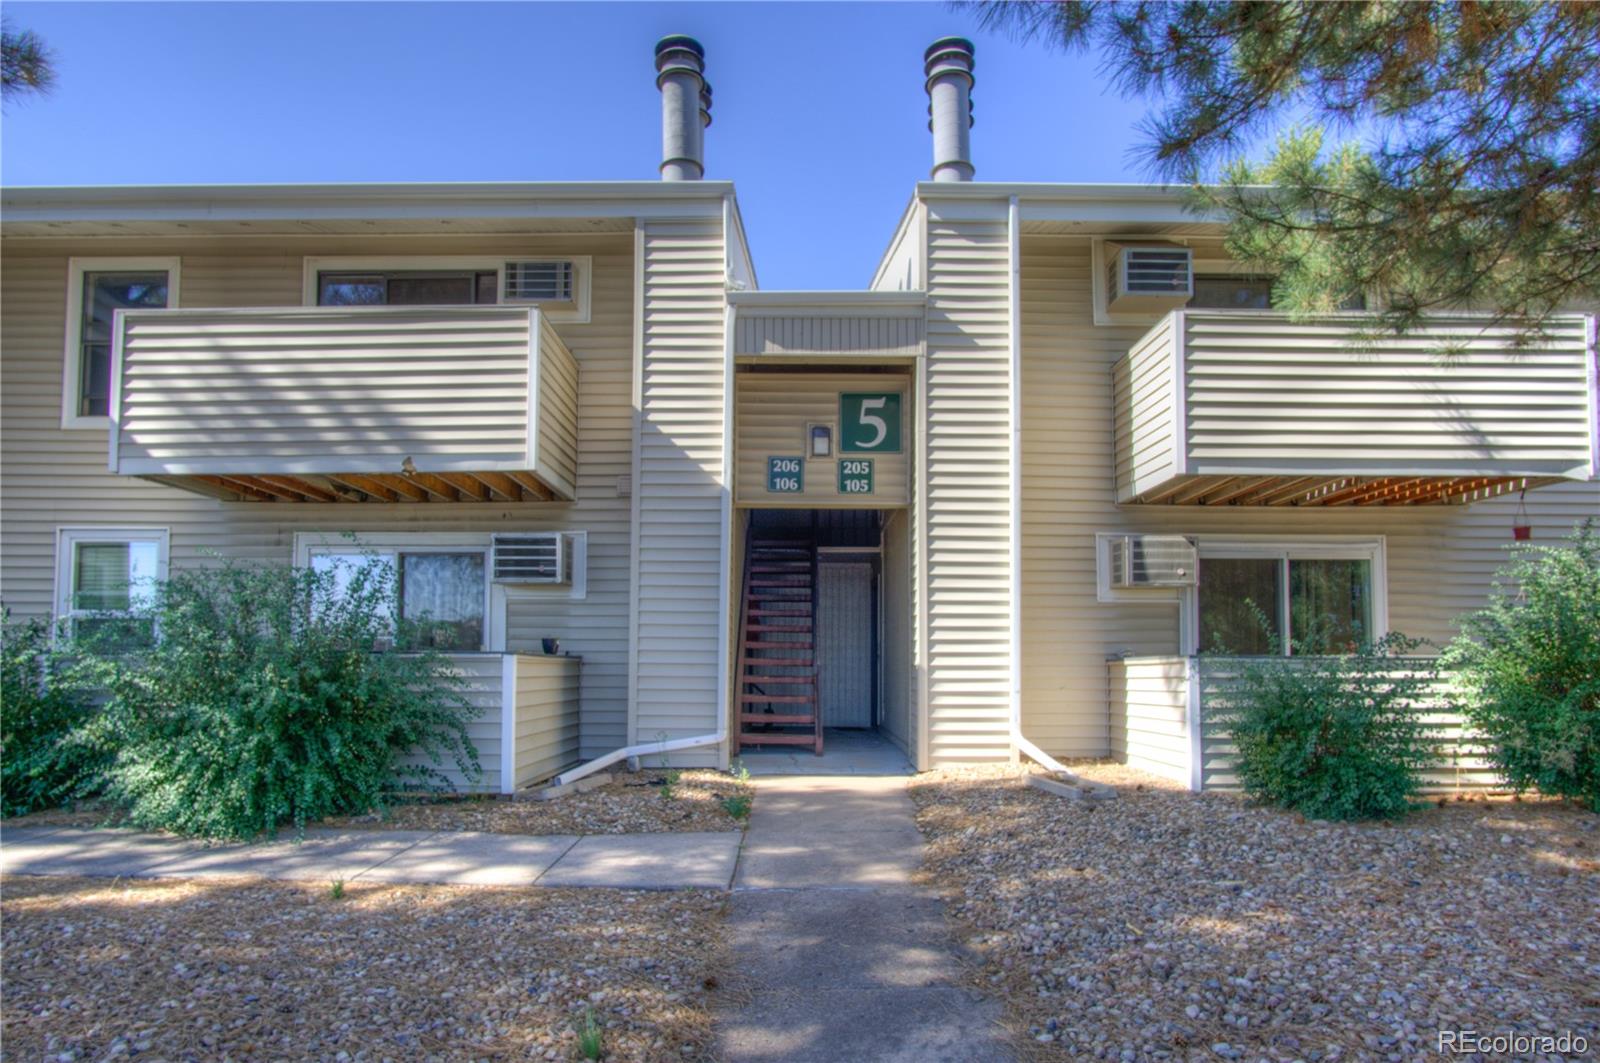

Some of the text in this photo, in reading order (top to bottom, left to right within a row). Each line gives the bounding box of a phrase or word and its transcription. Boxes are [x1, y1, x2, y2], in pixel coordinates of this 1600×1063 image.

[855, 396, 887, 448] 5
[773, 460, 799, 473] 206
[843, 462, 869, 474] 205
[774, 477, 798, 490] 106
[844, 480, 868, 492] 105
